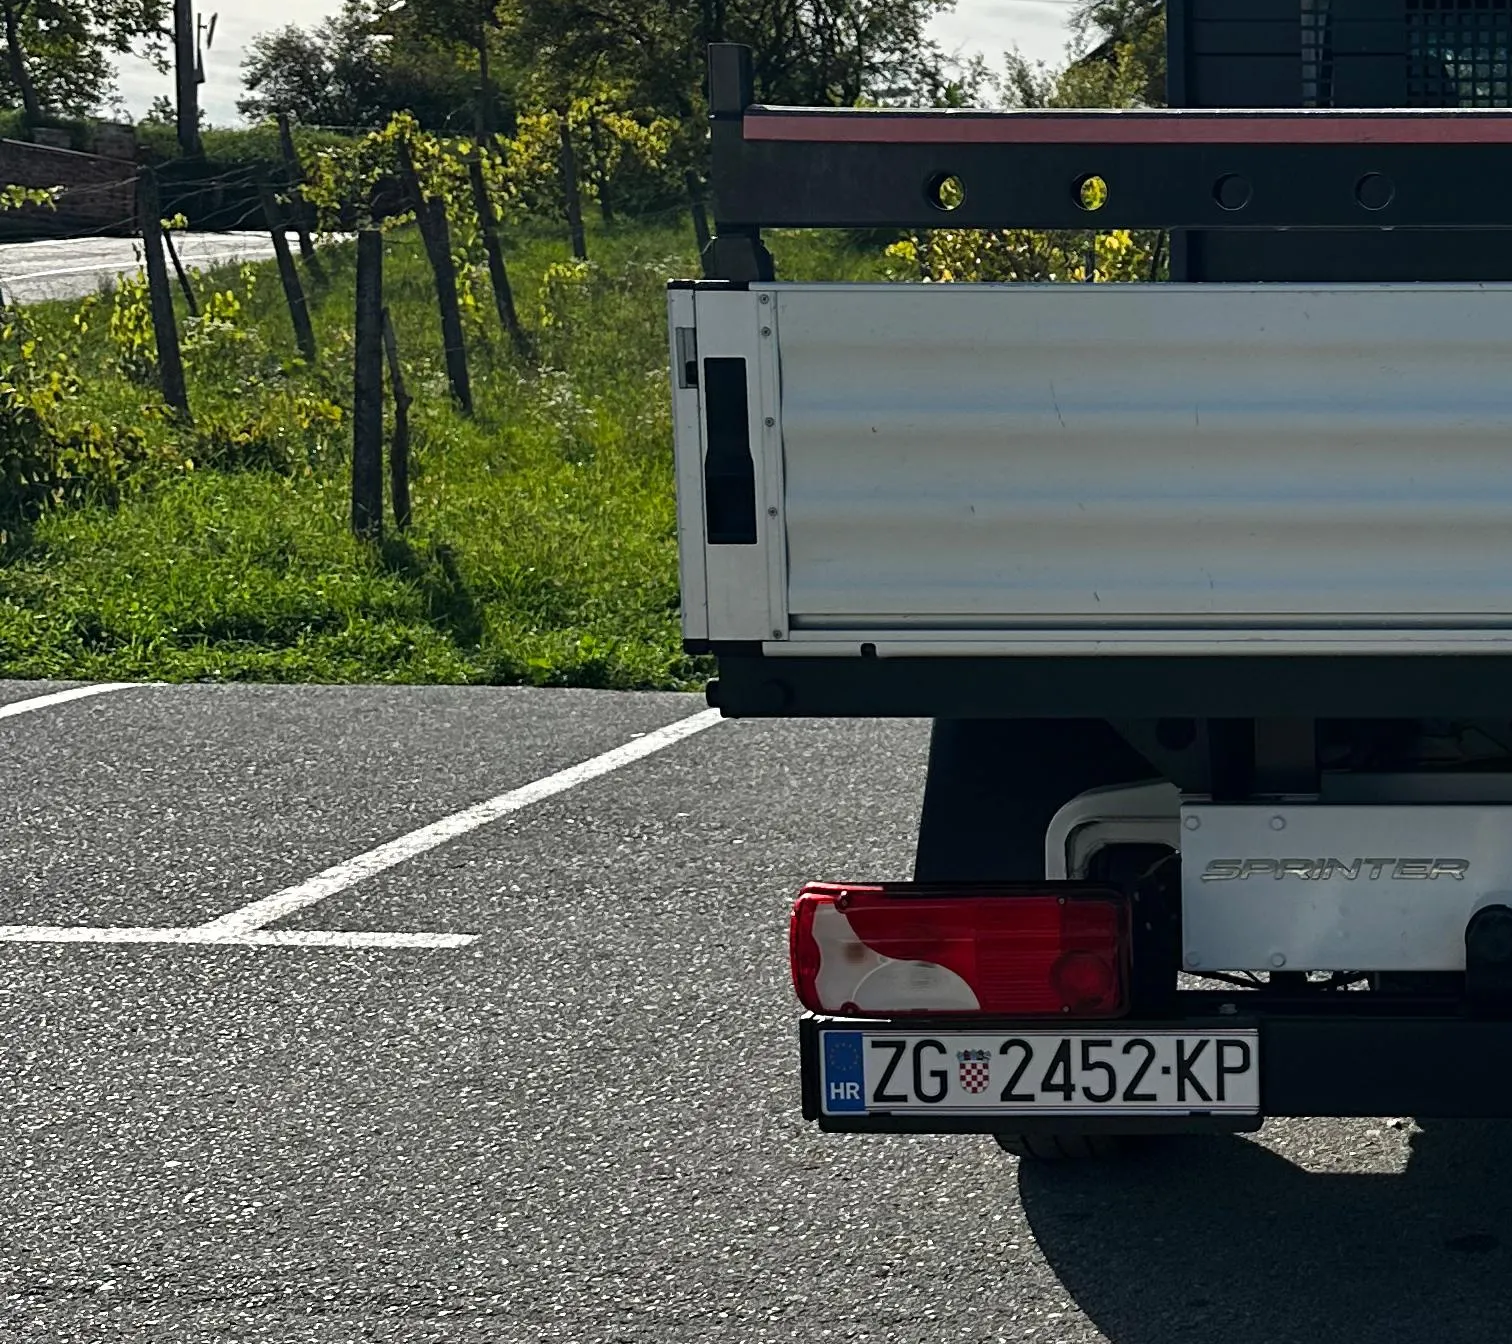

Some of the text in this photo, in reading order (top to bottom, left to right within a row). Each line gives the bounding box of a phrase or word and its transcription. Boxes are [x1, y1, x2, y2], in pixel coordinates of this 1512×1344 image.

[1200, 858, 1470, 882] SPRINTER
[871, 1039, 948, 1102] ZG
[830, 1081, 860, 1100] HR
